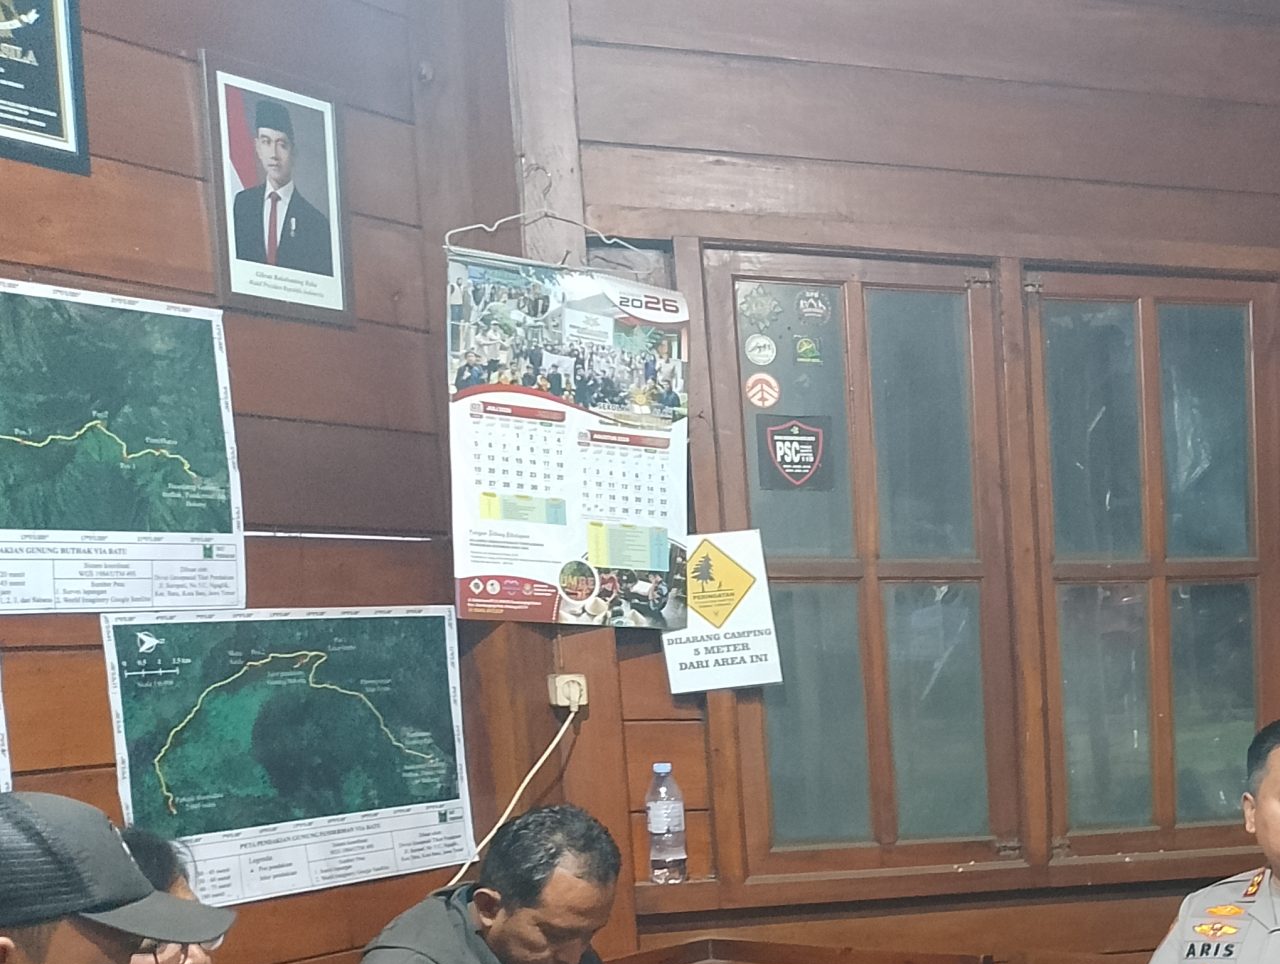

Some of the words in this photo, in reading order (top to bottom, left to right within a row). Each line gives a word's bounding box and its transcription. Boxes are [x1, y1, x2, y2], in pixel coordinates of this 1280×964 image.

[619, 295, 680, 314] 2026
[776, 441, 800, 463] PSC
[667, 633, 720, 645] DILARANG
[723, 628, 772, 639] CAMPING
[693, 647, 701, 656] 5
[704, 643, 751, 655] METER
[679, 660, 709, 671] DARI
[713, 656, 747, 667] AREA
[750, 653, 769, 663] INI
[1186, 942, 1235, 958] ARIS
